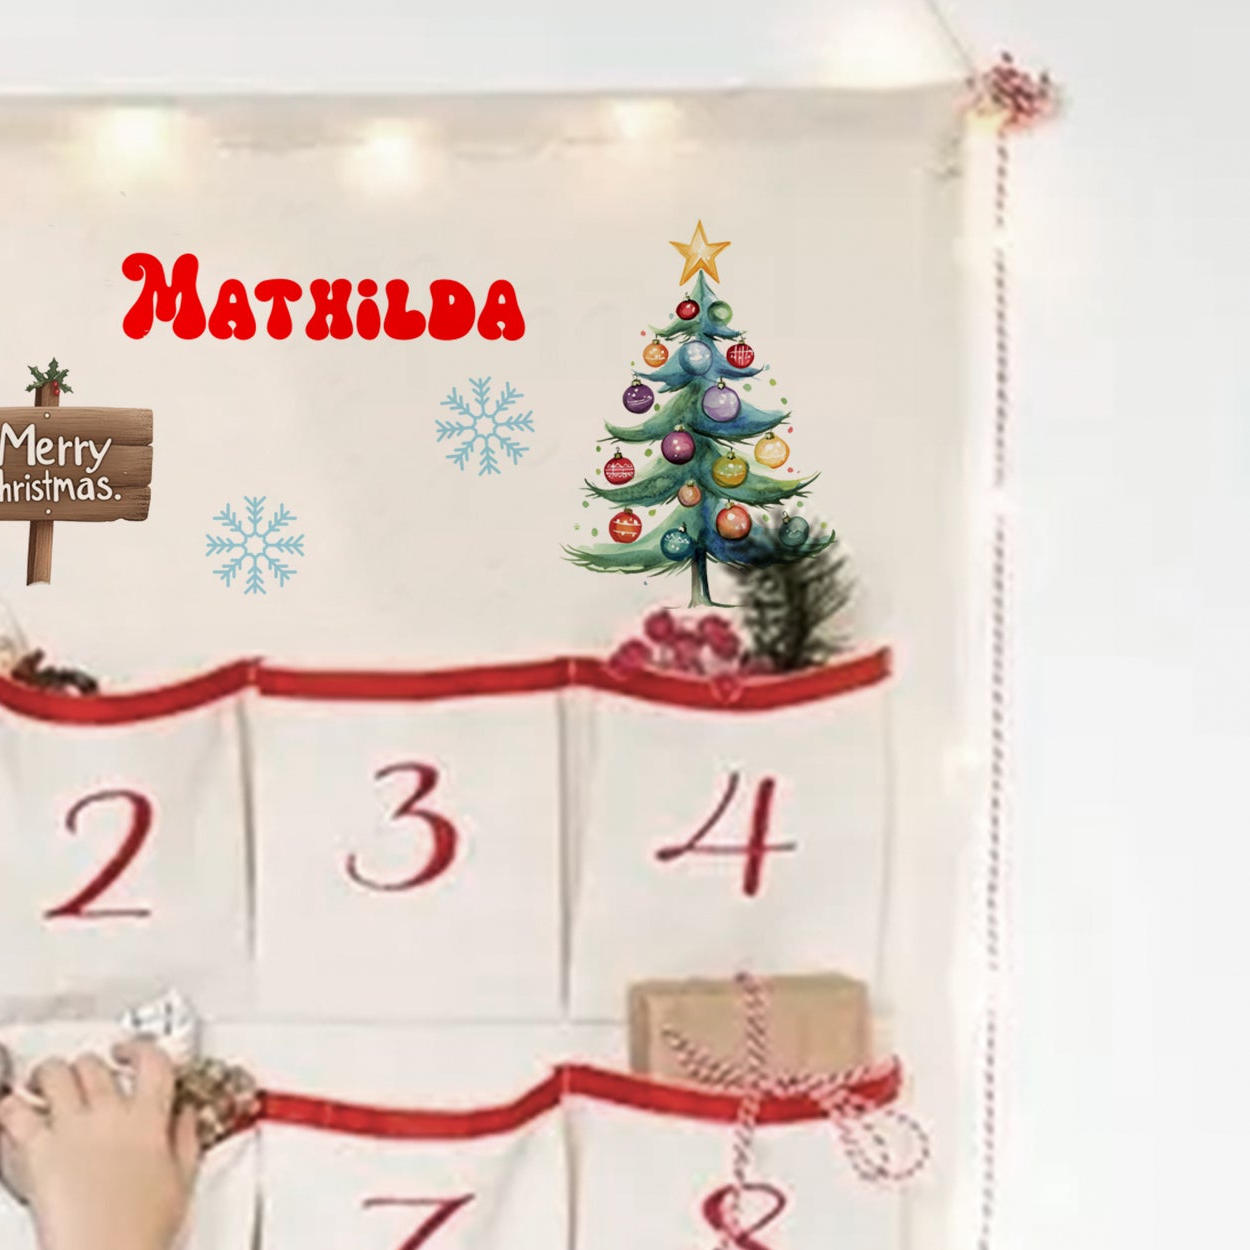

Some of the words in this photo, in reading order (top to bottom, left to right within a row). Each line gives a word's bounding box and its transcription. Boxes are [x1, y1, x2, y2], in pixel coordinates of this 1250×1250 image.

[43, 789, 154, 921] 2
[345, 761, 460, 893] 3
[654, 770, 797, 899] 4
